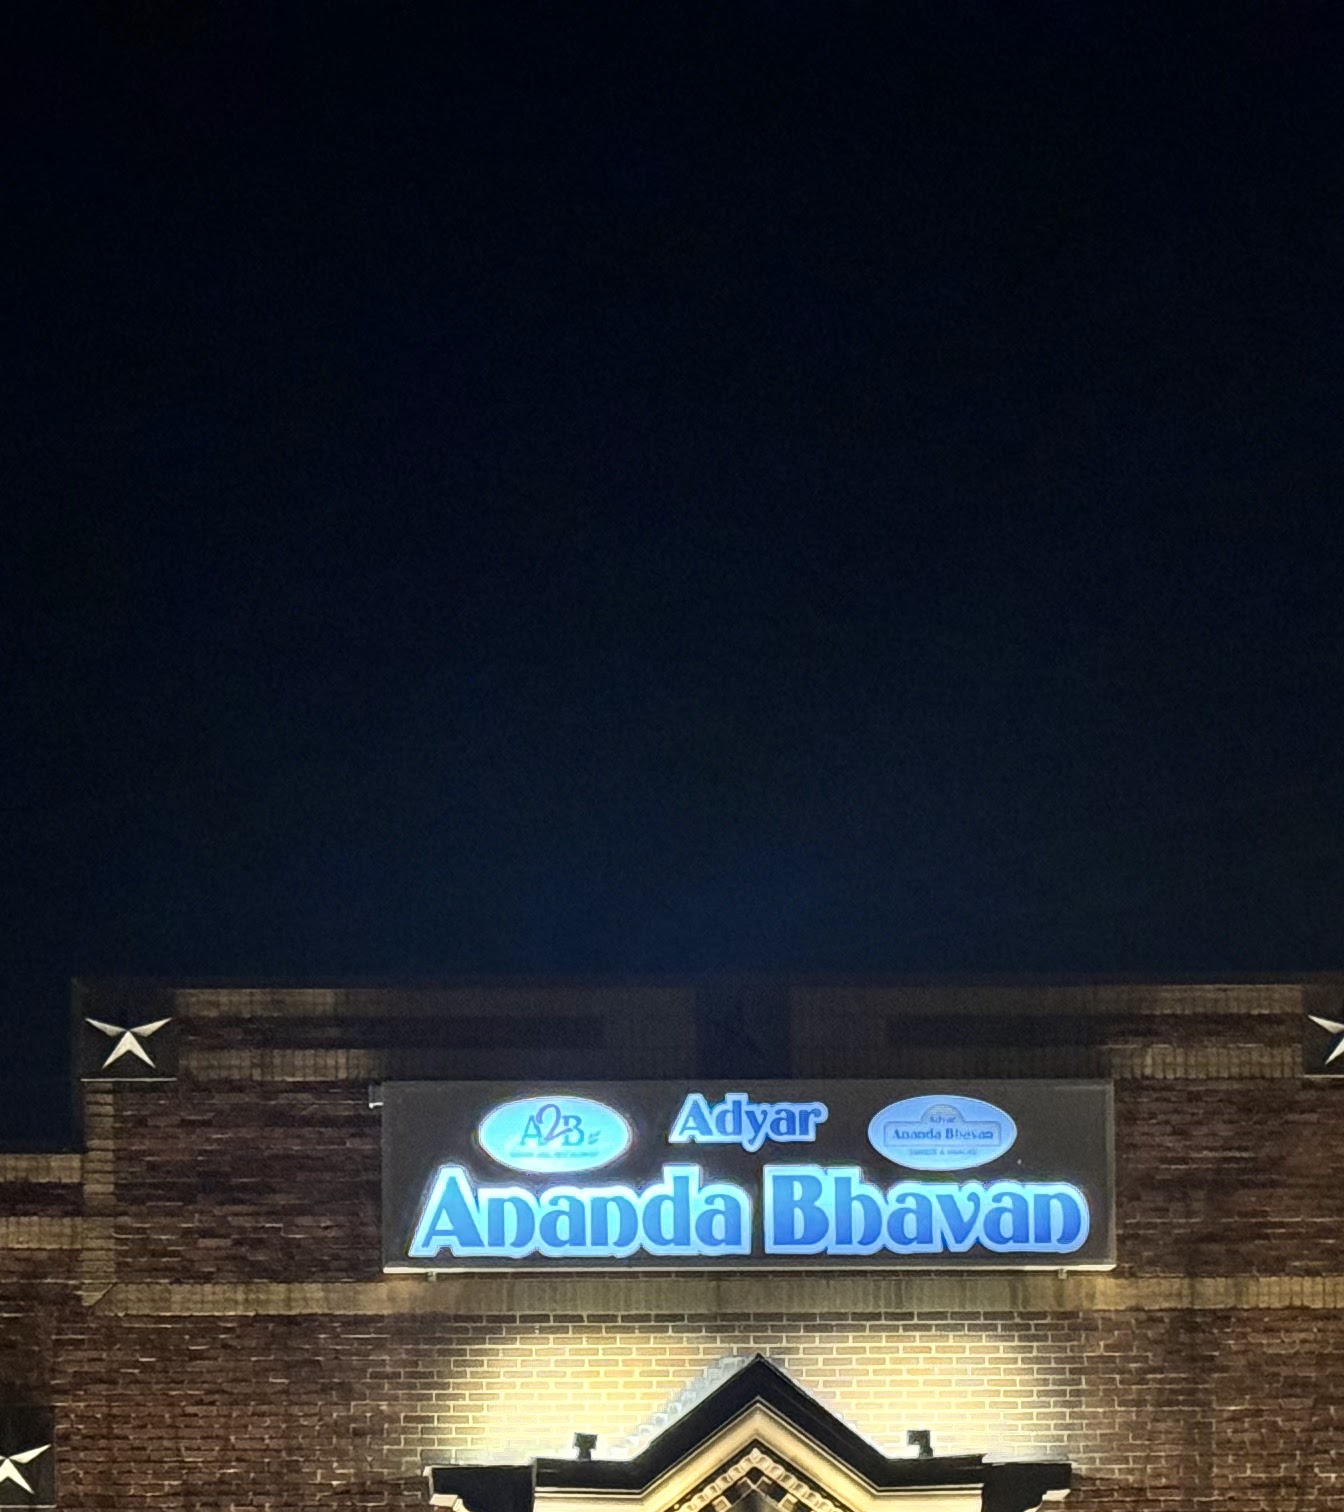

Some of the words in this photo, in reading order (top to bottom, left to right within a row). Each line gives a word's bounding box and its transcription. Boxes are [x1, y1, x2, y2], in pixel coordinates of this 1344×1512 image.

[520, 1104, 585, 1146] A2B
[673, 1096, 826, 1149] Adyar
[892, 1128, 942, 1140] Ananda
[945, 1128, 994, 1140] Bhavan
[415, 1170, 747, 1252] Ananda
[768, 1170, 1086, 1250] Bhavan
